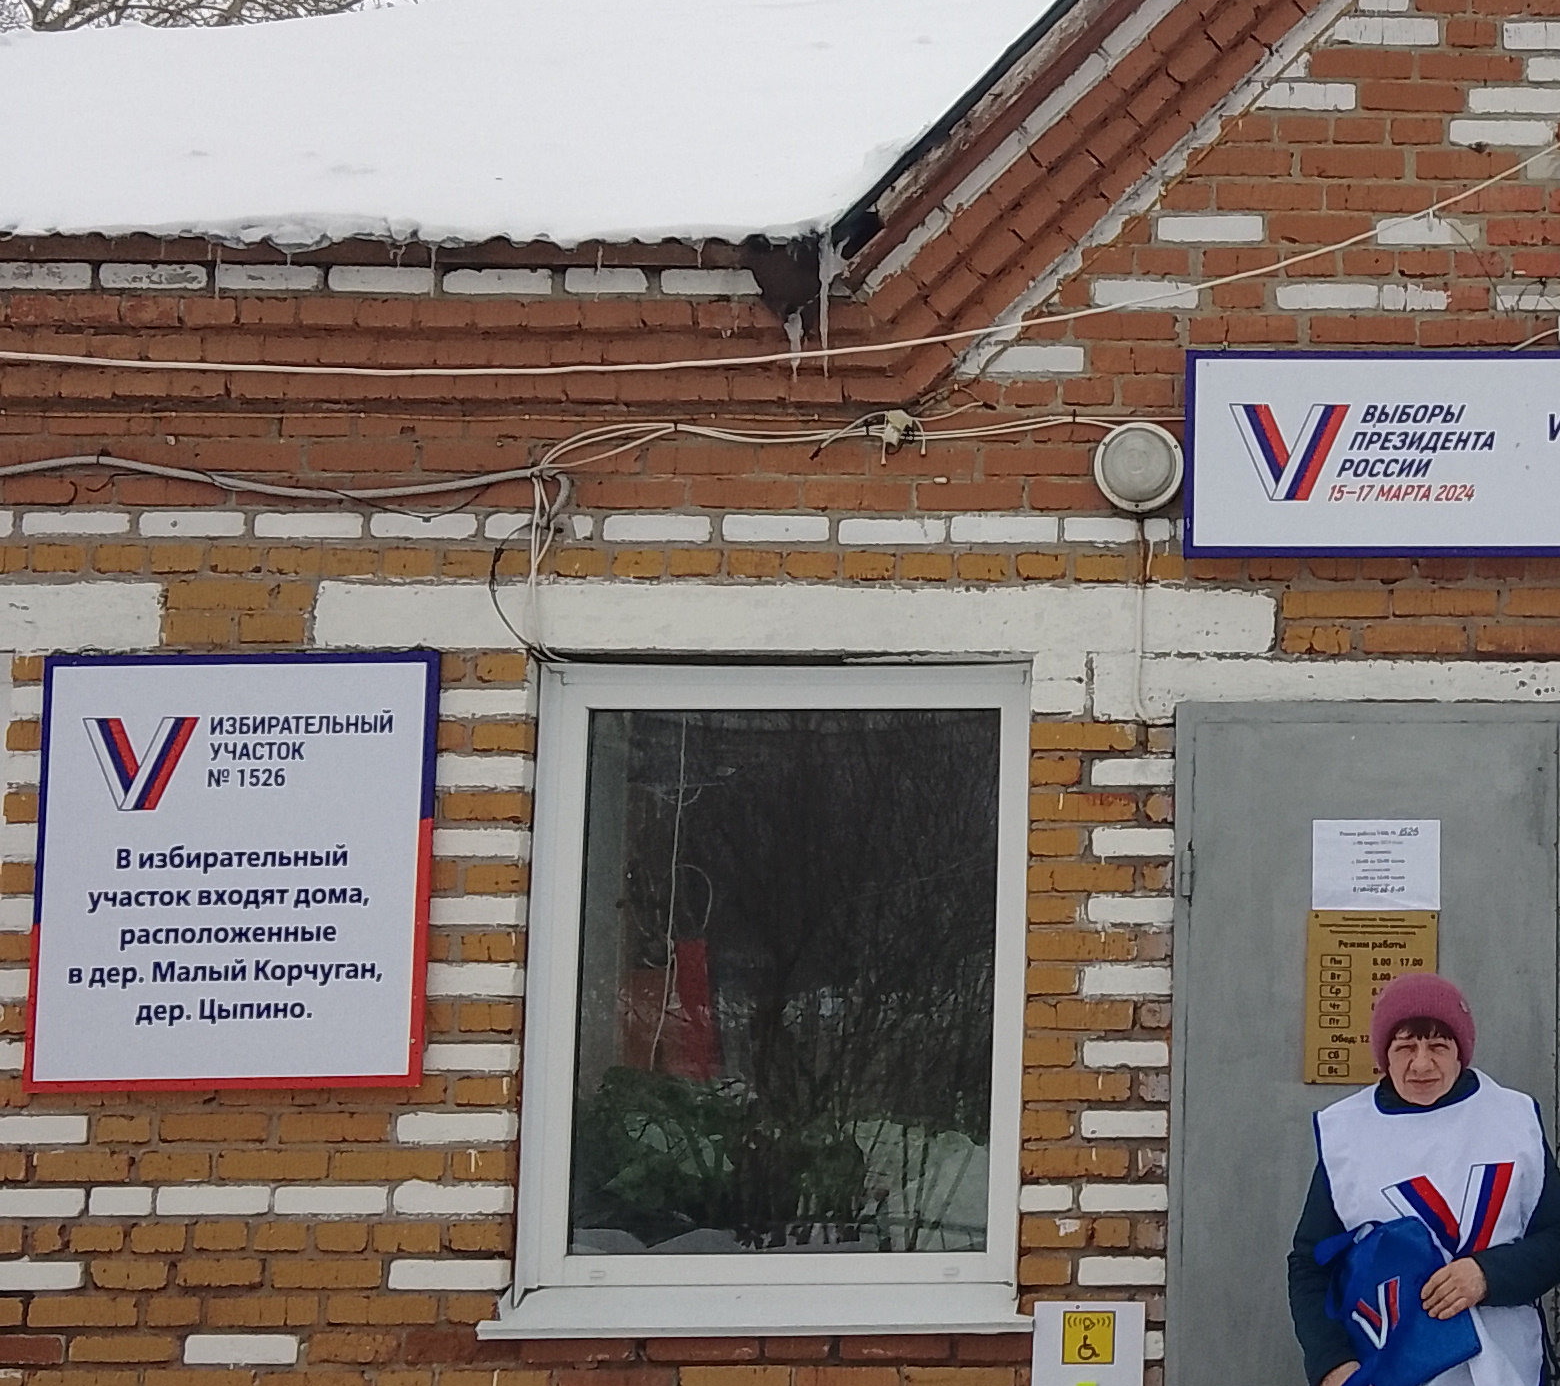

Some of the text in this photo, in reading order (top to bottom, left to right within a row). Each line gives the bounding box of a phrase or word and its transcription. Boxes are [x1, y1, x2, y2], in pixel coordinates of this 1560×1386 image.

[1360, 404, 1466, 424] ВЫБОРЫ
[1348, 431, 1495, 454] ПРЕЗИДЕНТА
[1336, 458, 1433, 478] РОССИИ
[1374, 484, 1432, 502] МАРТА
[1434, 484, 1475, 502] 2024
[210, 709, 394, 735] ИЗБИРАТЕЛЬНЫЙ
[210, 742, 305, 762] УЧАСТОК
[207, 767, 286, 788] № 1526
[116, 844, 349, 874] В избирательный
[88, 887, 370, 913] участок входят дома,
[120, 925, 337, 951] расположенные
[1338, 939, 1407, 951] Режим работы
[1372, 958, 1392, 967] 8.00
[1400, 958, 1424, 967] 17.00
[68, 958, 383, 989] в дер. Малый Корчуган,
[1330, 972, 1342, 981] Вт
[1371, 973, 1391, 981] 8.00
[1329, 986, 1342, 997] Ср
[135, 999, 313, 1027] дер. Цыпино.
[1329, 1002, 1341, 1011] Чт
[1328, 1017, 1340, 1026] Пт
[1331, 1034, 1357, 1045] Обед:
[1328, 1050, 1340, 1060] Сб
